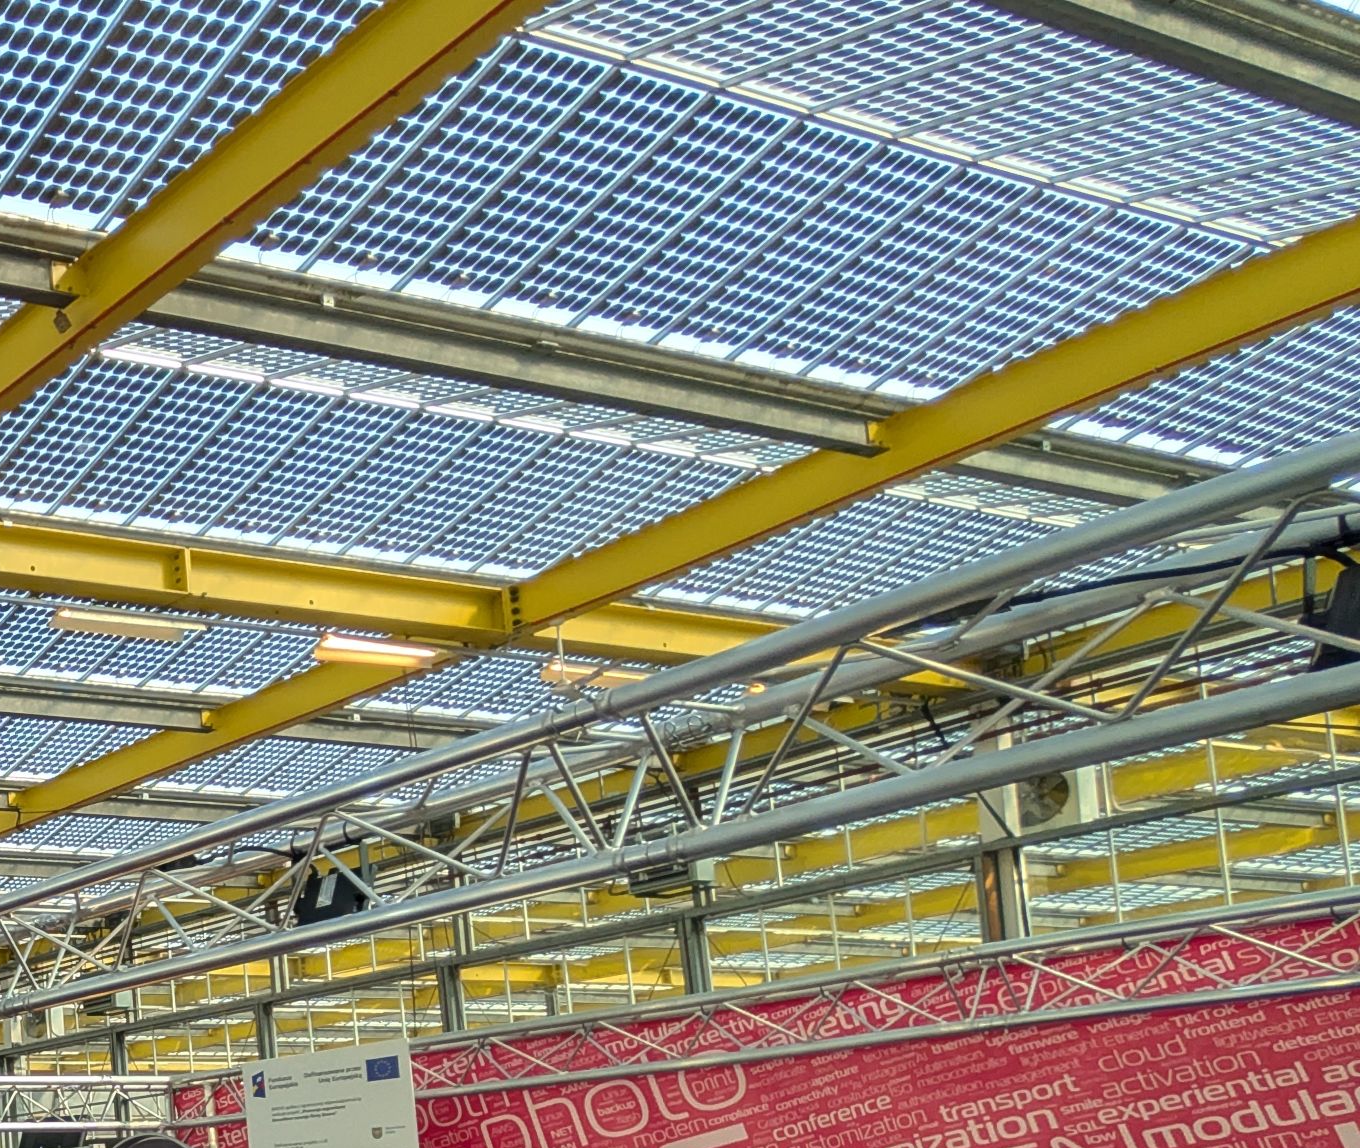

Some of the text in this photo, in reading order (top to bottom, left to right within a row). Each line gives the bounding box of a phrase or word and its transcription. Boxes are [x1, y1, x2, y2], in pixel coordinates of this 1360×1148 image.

[1169, 1004, 1240, 1028] TikTok
[1276, 990, 1351, 1016] Twitter
[604, 1016, 688, 1055] modular
[1086, 1011, 1152, 1034] voltage
[1102, 1021, 1171, 1047] Ethernet
[1183, 1010, 1266, 1039] frontend
[1212, 1016, 1309, 1048] lightweight
[931, 1034, 984, 1055] thermal
[985, 1025, 1038, 1048] upload
[1008, 1029, 1079, 1055] firmware
[1097, 1034, 1187, 1073] cloud
[691, 1068, 737, 1098] print
[811, 1065, 859, 1087] aperture
[985, 1059, 1080, 1090] management
[1100, 1049, 1262, 1099] activation
[775, 1085, 839, 1111] connectivity
[939, 1073, 1080, 1123] transport
[1097, 1061, 1310, 1124] experiential
[597, 1099, 636, 1117] backup
[708, 1102, 770, 1125] compliance
[773, 1095, 892, 1141] conference
[1060, 1097, 1104, 1116] smile
[633, 1117, 708, 1148] modern
[1063, 1120, 1106, 1137] SQL
[1084, 1131, 1117, 1145] low
[1301, 1128, 1330, 1139] LAN
